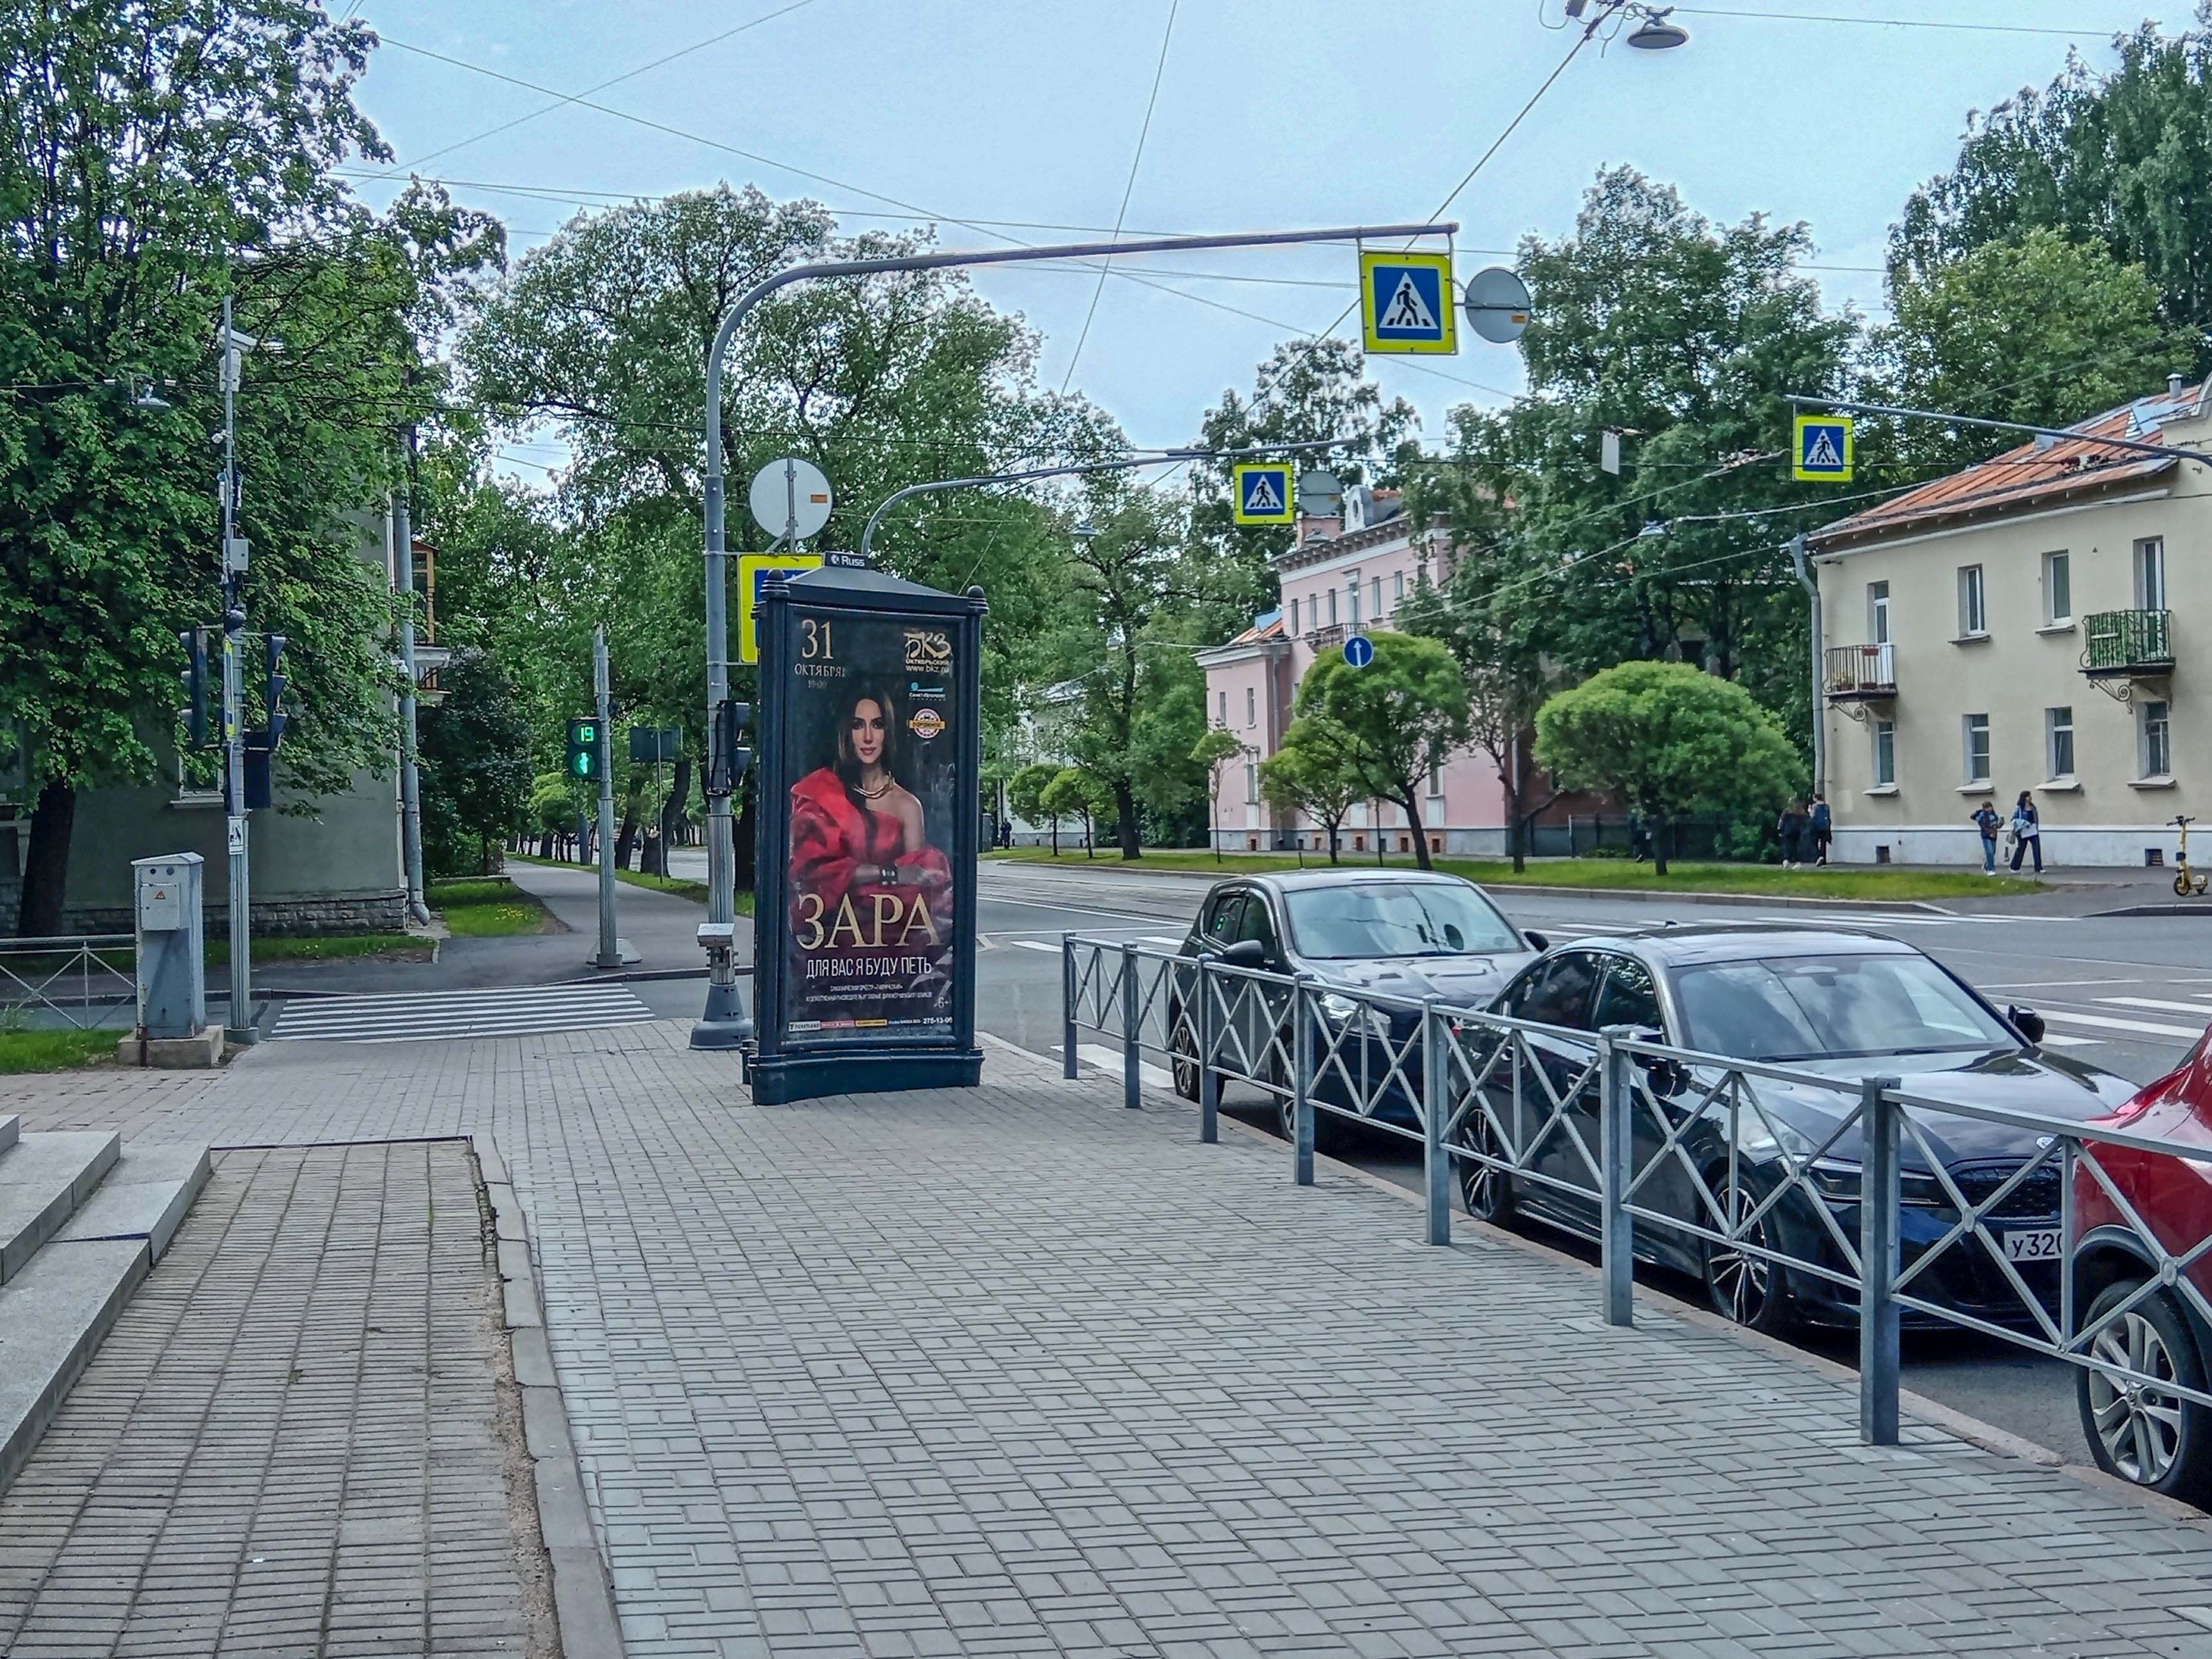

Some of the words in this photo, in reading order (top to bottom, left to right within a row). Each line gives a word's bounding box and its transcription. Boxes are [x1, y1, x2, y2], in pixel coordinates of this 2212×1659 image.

[802, 619, 834, 659] 31
[903, 631, 953, 659] БКЗ
[794, 663, 842, 678] ОКТЯБРЯ
[581, 726, 594, 742] 19
[796, 892, 944, 951] ЗАРА
[806, 959, 829, 979] ДЛЯ
[831, 959, 853, 976] ВАС
[856, 959, 864, 975] Я
[866, 958, 898, 977] БУДУ
[901, 957, 932, 974] ПЕТЬ
